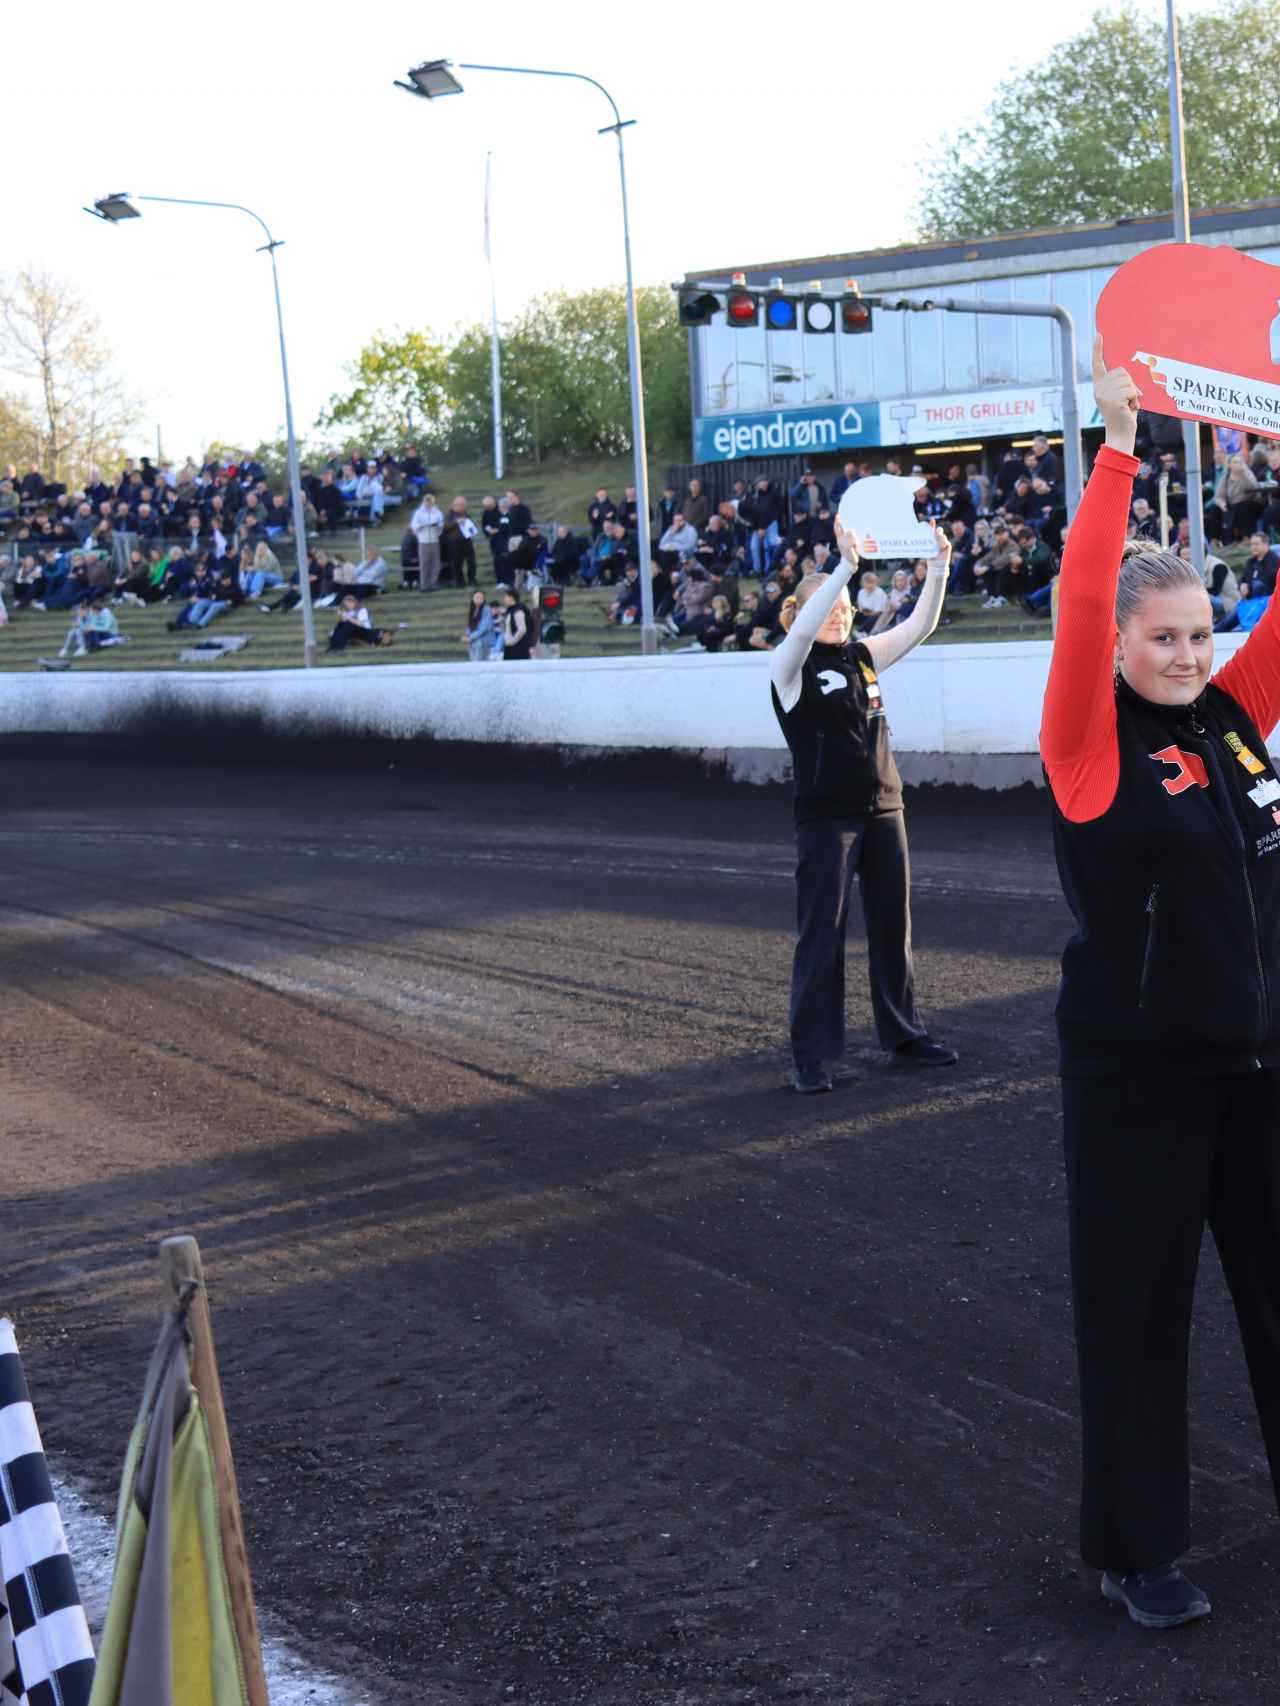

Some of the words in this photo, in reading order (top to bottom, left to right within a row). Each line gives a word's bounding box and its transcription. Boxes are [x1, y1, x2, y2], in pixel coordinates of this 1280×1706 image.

[924, 406, 965, 423] THOR
[969, 399, 1036, 419] GRILLEN
[1219, 406, 1246, 420] Nebel
[1247, 415, 1260, 425] og
[714, 413, 837, 460] ejendrøm
